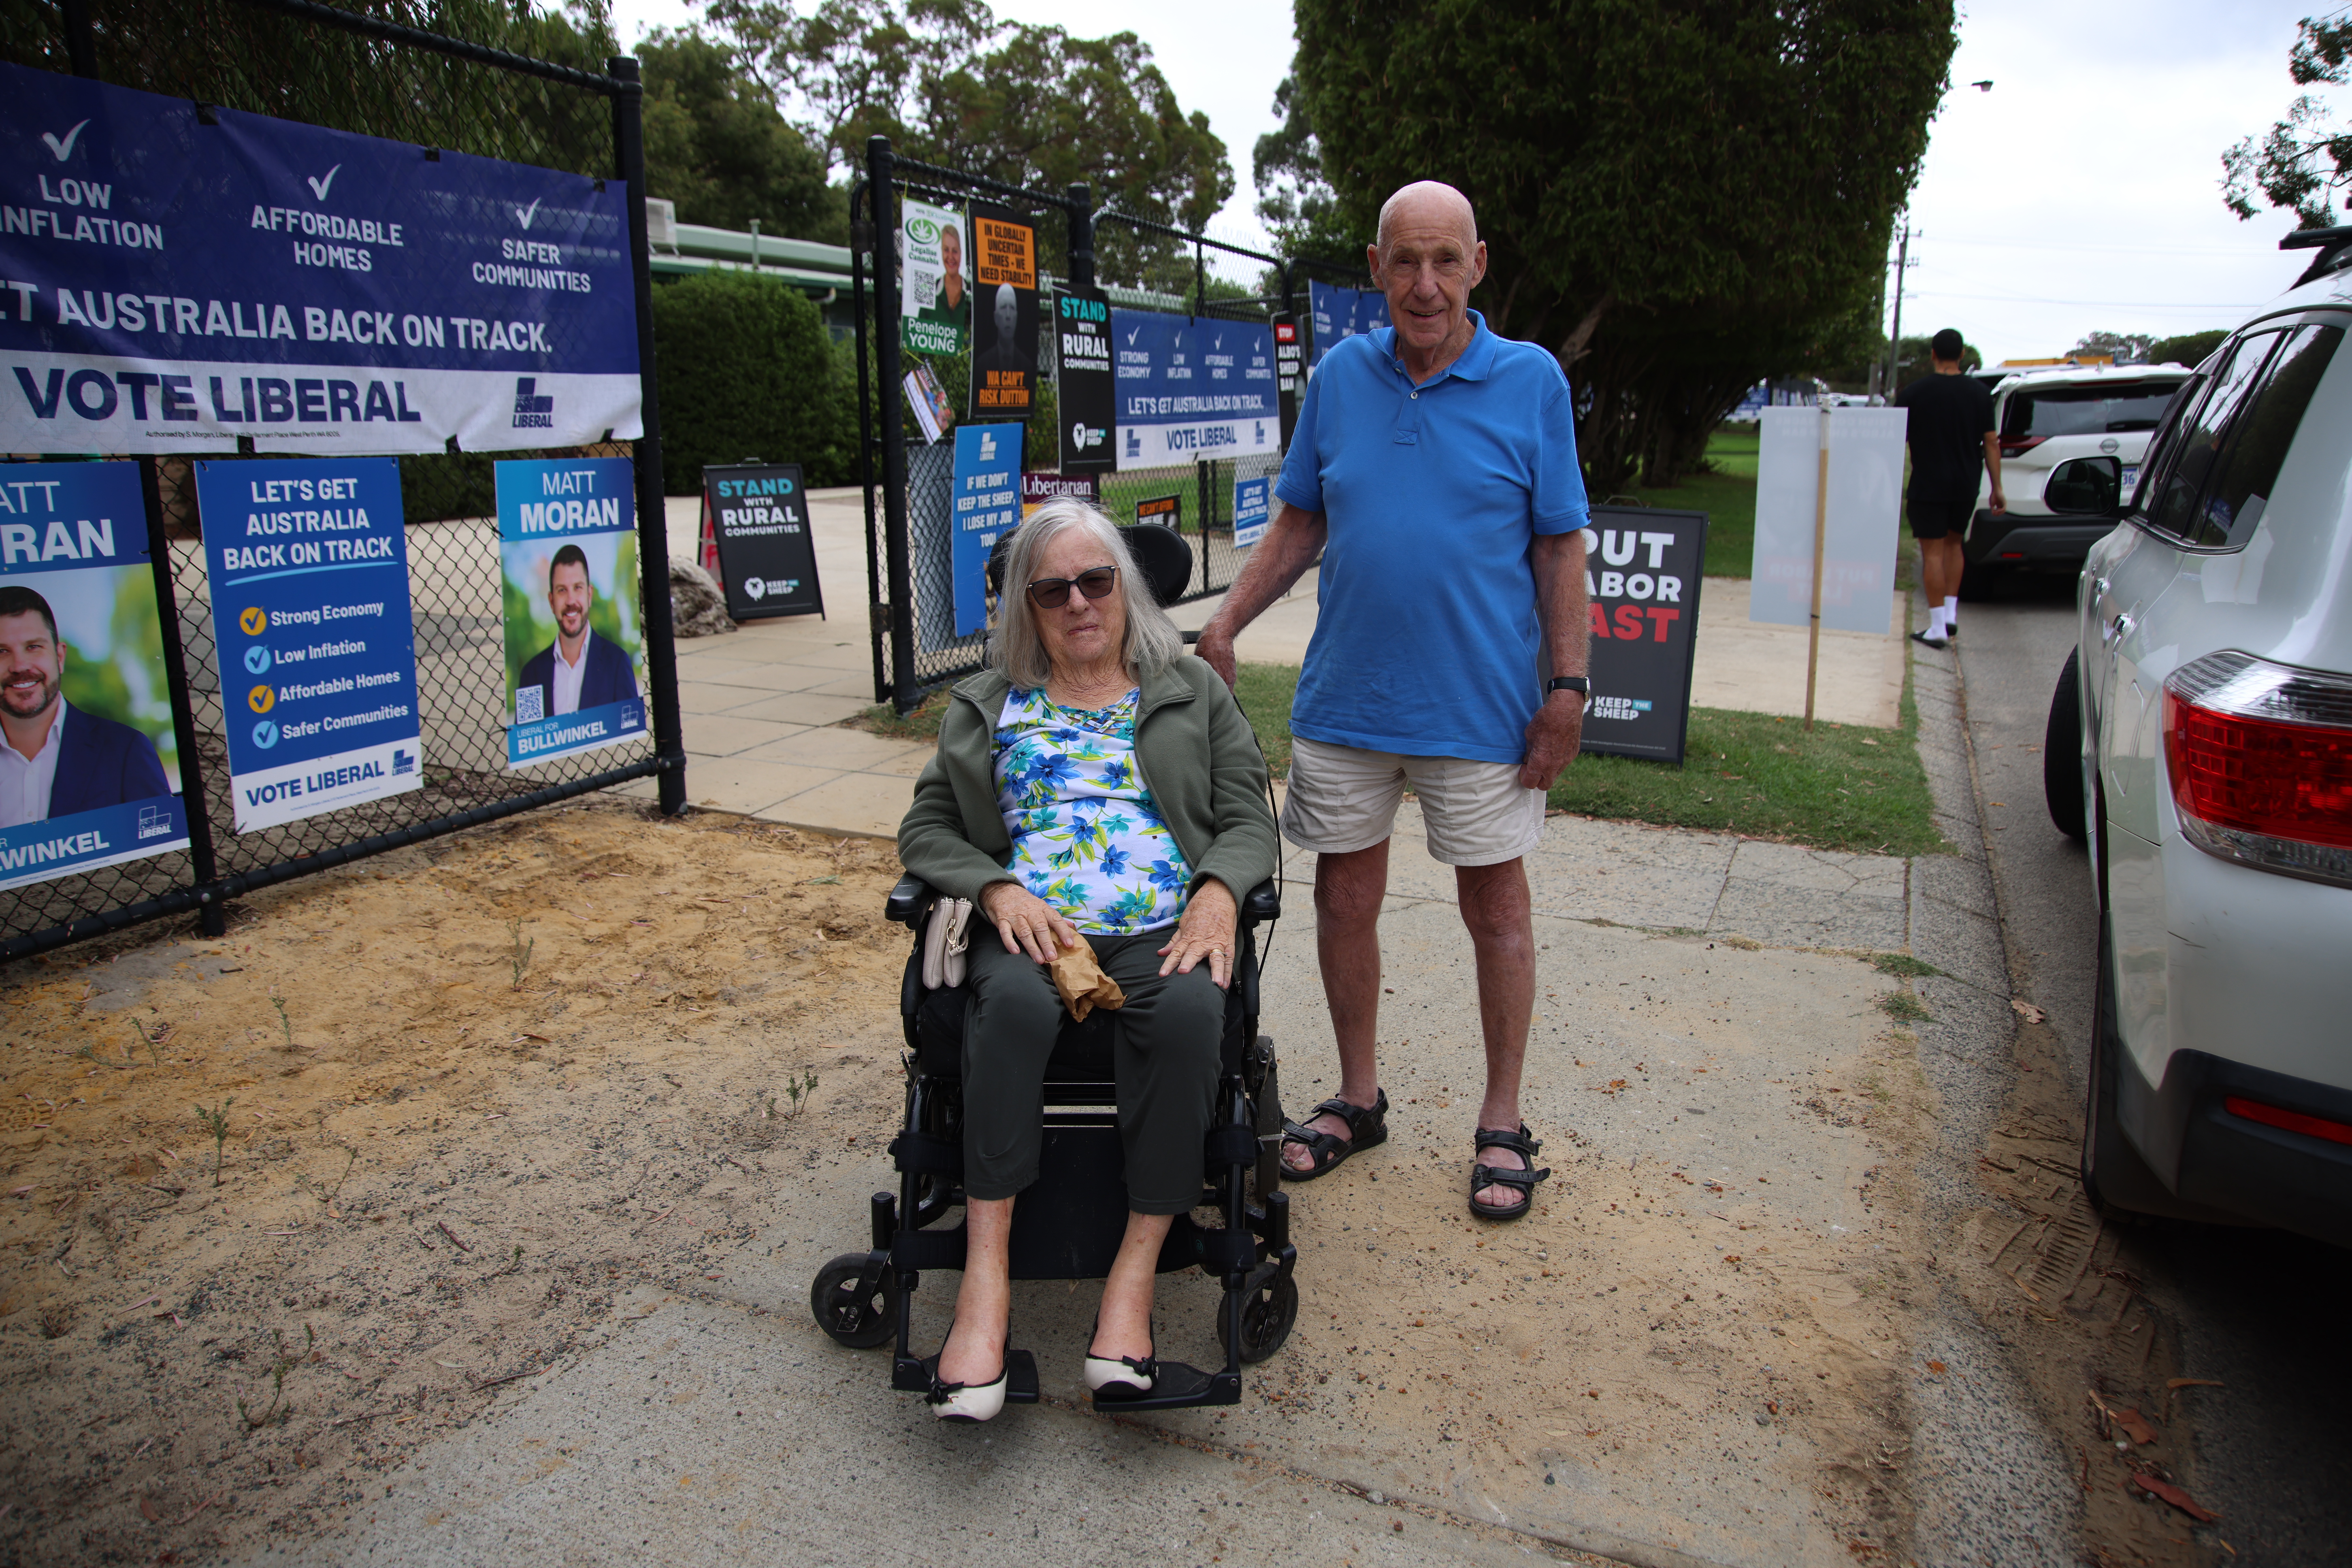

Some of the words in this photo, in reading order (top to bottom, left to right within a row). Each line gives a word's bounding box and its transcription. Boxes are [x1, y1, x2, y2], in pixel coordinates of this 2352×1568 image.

[38, 175, 111, 209] LOW
[0, 205, 163, 250] NFLATION
[251, 205, 404, 247] AFFORDABLE
[984, 223, 993, 235] IN
[995, 226, 1026, 242] GLOBALLY
[294, 241, 371, 273] HOMES
[503, 239, 561, 265] SAFER
[911, 243, 937, 256] Legalise
[988, 239, 1025, 256] UNCERTAIN
[908, 252, 939, 265] Cannabis
[988, 254, 1009, 267] TIMES
[1016, 257, 1025, 270] WE
[473, 262, 591, 293] COMMUNITIES
[981, 266, 999, 279] NEED
[1001, 269, 1032, 285] STABILITY
[1061, 297, 1106, 322] STAND
[58, 288, 297, 341] AUSTRALIA
[305, 307, 398, 346] BACK
[403, 315, 445, 347] ON
[450, 318, 553, 353] TRACK.
[908, 319, 957, 339] Penelope
[1078, 322, 1096, 334] WITH
[908, 332, 955, 353] YOUNG
[1278, 327, 1293, 339] STOP
[1063, 334, 1109, 358] RURAL
[1278, 345, 1301, 359] ALBO'S
[1064, 358, 1109, 371] COMMUNITIES
[1120, 351, 1149, 364] STRONG
[1173, 353, 1185, 365] LOW
[1118, 366, 1151, 378] ECONOMY
[1279, 361, 1299, 375] SHEEP
[986, 370, 999, 386] WA
[1001, 371, 1025, 386] CAN'T
[1280, 378, 1295, 392] BAN
[12, 366, 198, 421] VOTE
[209, 376, 421, 422] LIBERAL
[979, 389, 998, 404] RISK
[1000, 389, 1029, 404] DUTTON
[1128, 397, 1156, 415] LET'S
[1158, 397, 1172, 414] GET
[1173, 396, 1214, 413] AUSTRALIA
[1214, 395, 1231, 412] BACK
[1232, 395, 1241, 411] ON
[1241, 394, 1264, 409] TRACK.
[512, 414, 553, 428] LIBERAL
[1087, 429, 1099, 437] KEEP
[1087, 437, 1102, 445] SHEEP
[1167, 428, 1196, 450] VOTE
[1199, 426, 1237, 447] LIBERAL
[980, 452, 995, 461] LIBERAL
[543, 471, 597, 495] MATT
[718, 478, 793, 497] STAND
[967, 477, 974, 489] IF
[976, 476, 986, 489] WE
[988, 472, 1008, 488] DON'T
[1023, 475, 1091, 495] Libertarian
[2122, 473, 2135, 485] 36
[0, 481, 60, 513] ATT
[251, 480, 314, 503] LET'S
[319, 478, 358, 500] GET
[744, 497, 773, 506] WITH
[957, 497, 976, 512] KEEP
[977, 495, 991, 509] THE
[992, 491, 1015, 507] SHEEP,
[246, 508, 371, 536] AUSTRALIA
[520, 498, 620, 533] MORAN
[722, 506, 799, 526] RURAL
[963, 518, 966, 531] I
[967, 516, 985, 530] LOSE
[986, 513, 997, 526] MY
[999, 511, 1012, 524] JOB
[725, 524, 800, 537] COMMUNITIES
[0, 519, 116, 564] RAN
[980, 533, 996, 548] TOO!
[224, 545, 287, 570] BACK
[291, 542, 321, 565] ON
[324, 537, 394, 561] TRACK
[767, 587, 793, 595] SHEEP
[1588, 571, 1681, 602] BOR
[271, 609, 320, 626] Strong
[323, 603, 384, 619] Economy
[1587, 603, 1679, 643] AST
[275, 649, 306, 664] Low
[309, 640, 366, 660] Inflation
[280, 677, 354, 702] Affordable
[356, 671, 401, 688] Homes
[1595, 695, 1632, 709] KEEP
[283, 721, 321, 739] Safer
[324, 704, 409, 731] Communities
[1594, 707, 1639, 720] SHEEP
[517, 724, 543, 738] LIBERAL
[545, 722, 559, 731] FOR
[621, 720, 639, 729] LIBERAL
[518, 721, 607, 754] BULLWINKEL
[392, 765, 413, 776] LIBERAL
[246, 779, 302, 807] VOTE
[307, 761, 384, 793] LIBERAL
[138, 824, 172, 839] LIBERAL
[0, 831, 110, 871] WINKEL
